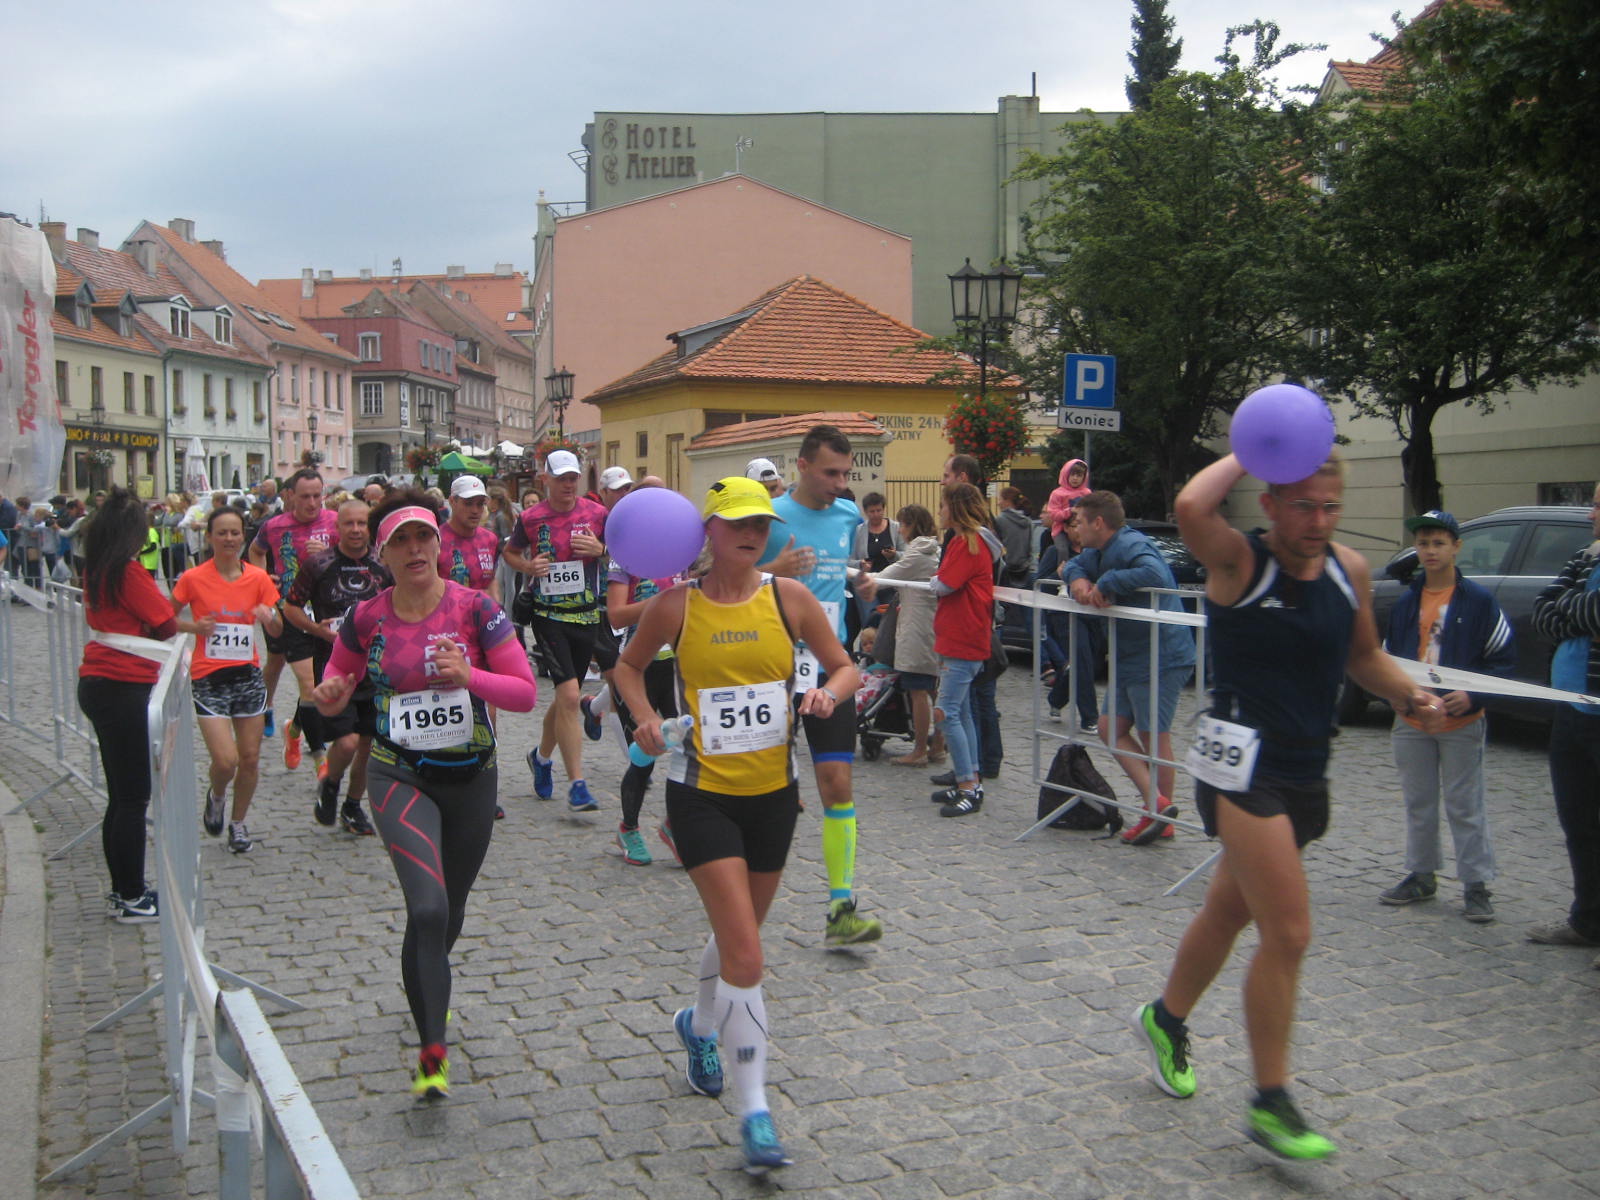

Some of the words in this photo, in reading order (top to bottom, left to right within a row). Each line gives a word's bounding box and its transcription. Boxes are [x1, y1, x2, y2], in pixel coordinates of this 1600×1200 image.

[626, 123, 696, 149] HOTEL
[625, 153, 696, 179] ATELIER
[17, 290, 41, 435] Torggler
[1076, 360, 1104, 400] P
[879, 416, 913, 428] RKING
[918, 416, 941, 429] 24h
[1065, 411, 1114, 427] Koniec
[851, 451, 882, 467] KING
[847, 472, 862, 481] TEL
[546, 571, 580, 583] 1566
[211, 634, 249, 647] 2114
[794, 662, 810, 676] 6
[399, 705, 464, 730] 1965
[720, 704, 771, 728] 516
[1192, 735, 1243, 767] 399
